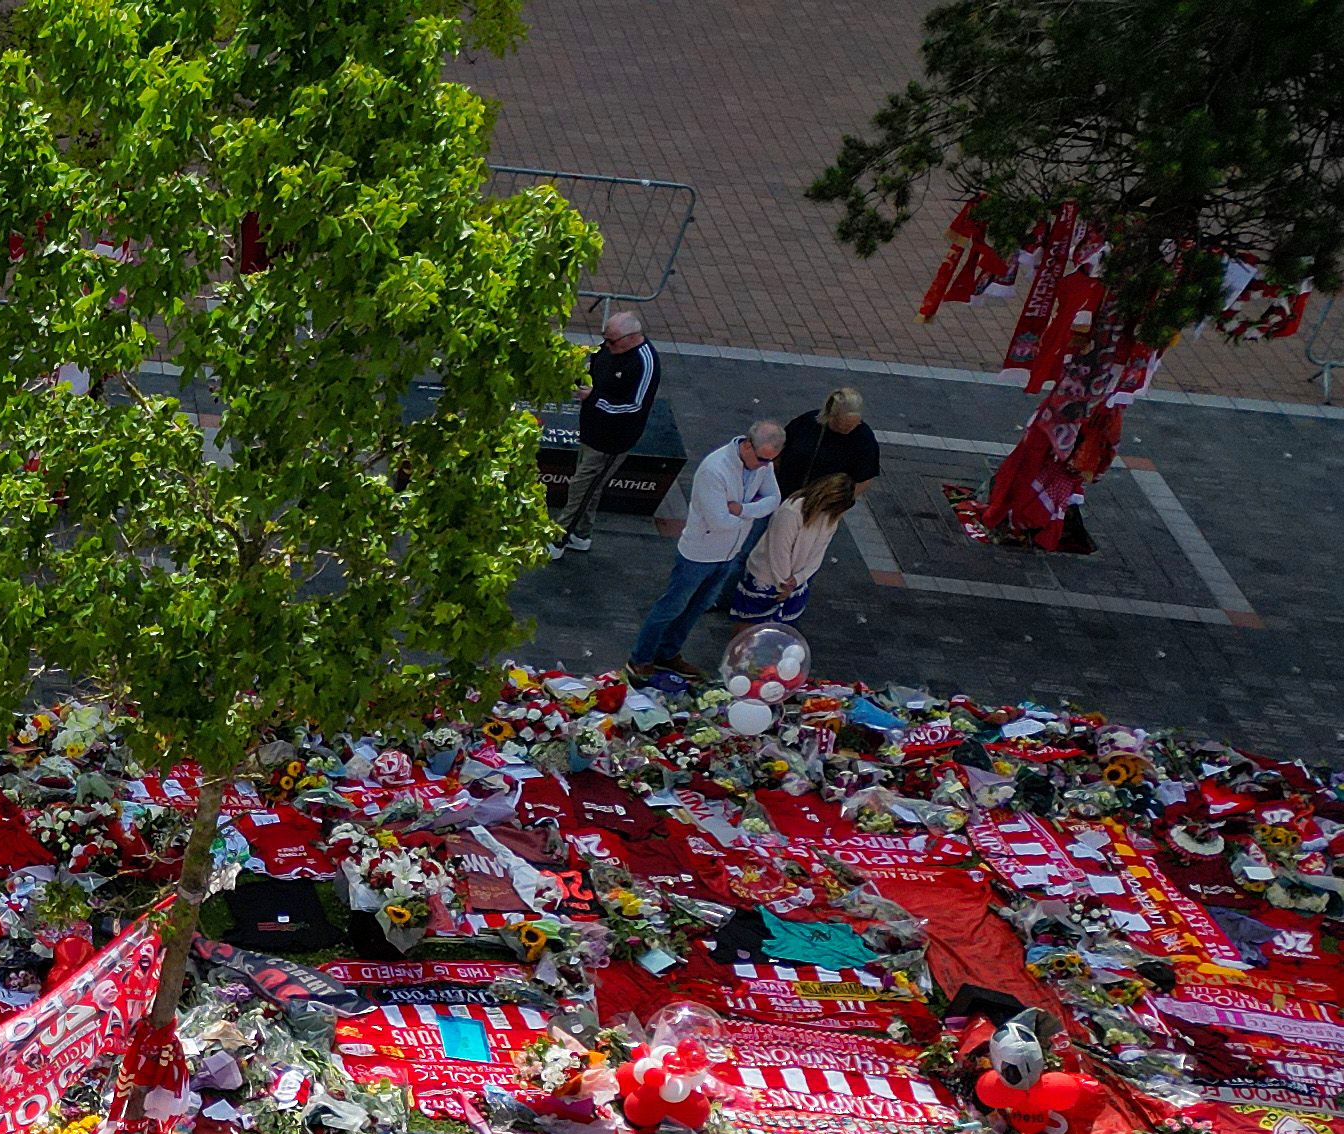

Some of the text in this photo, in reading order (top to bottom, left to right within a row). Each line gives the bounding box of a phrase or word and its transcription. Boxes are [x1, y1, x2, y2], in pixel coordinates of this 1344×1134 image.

[608, 478, 657, 491] FATHER
[1184, 989, 1305, 1018] LIVERPOOL
[766, 1088, 924, 1117] CHAMPIONS
